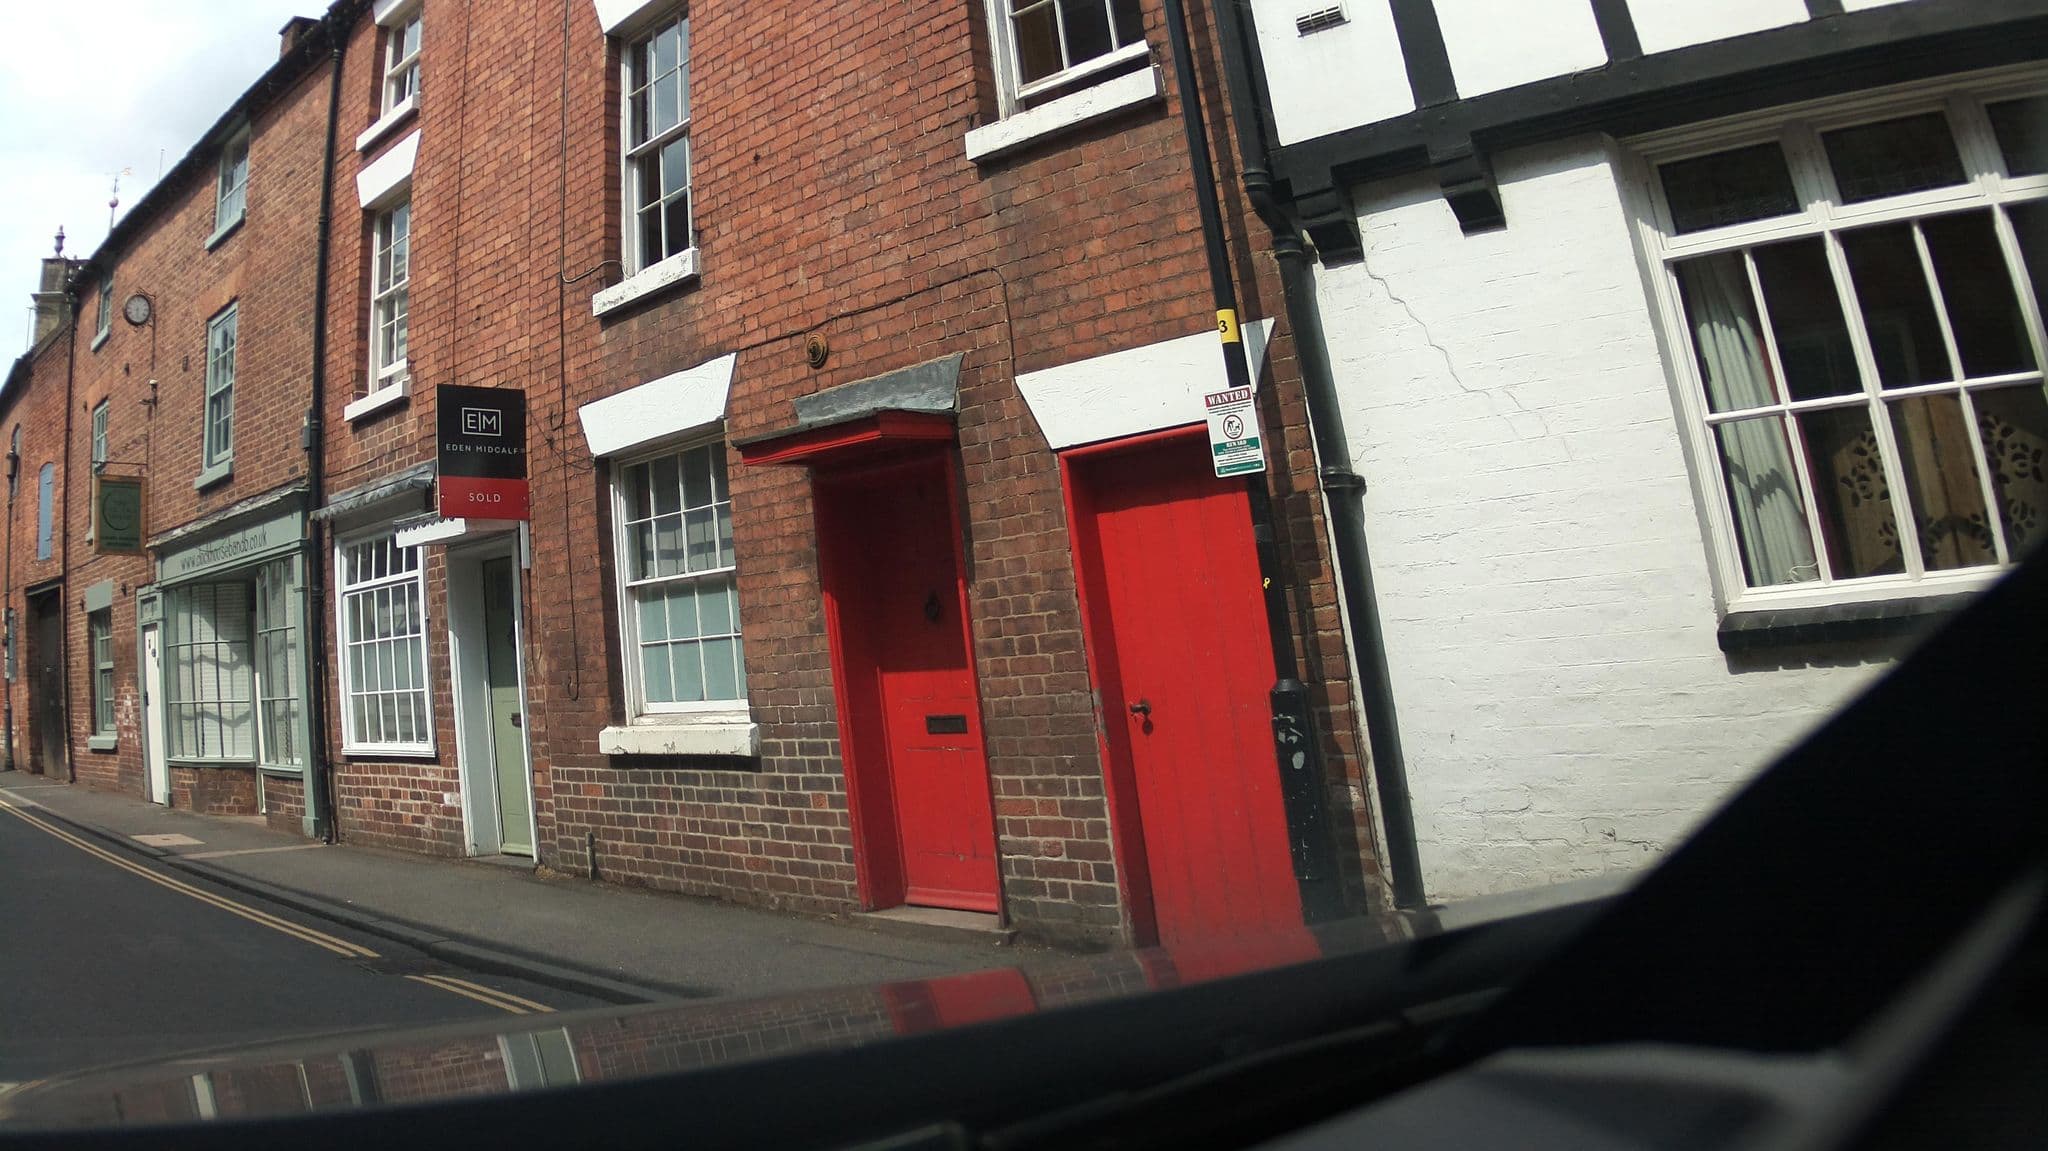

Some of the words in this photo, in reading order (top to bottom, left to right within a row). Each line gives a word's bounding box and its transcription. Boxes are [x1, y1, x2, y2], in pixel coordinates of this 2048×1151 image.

[1219, 320, 1228, 333] 3
[1207, 389, 1248, 406] WANTED
[445, 443, 472, 452] EDEN
[468, 492, 501, 503] SOLD
